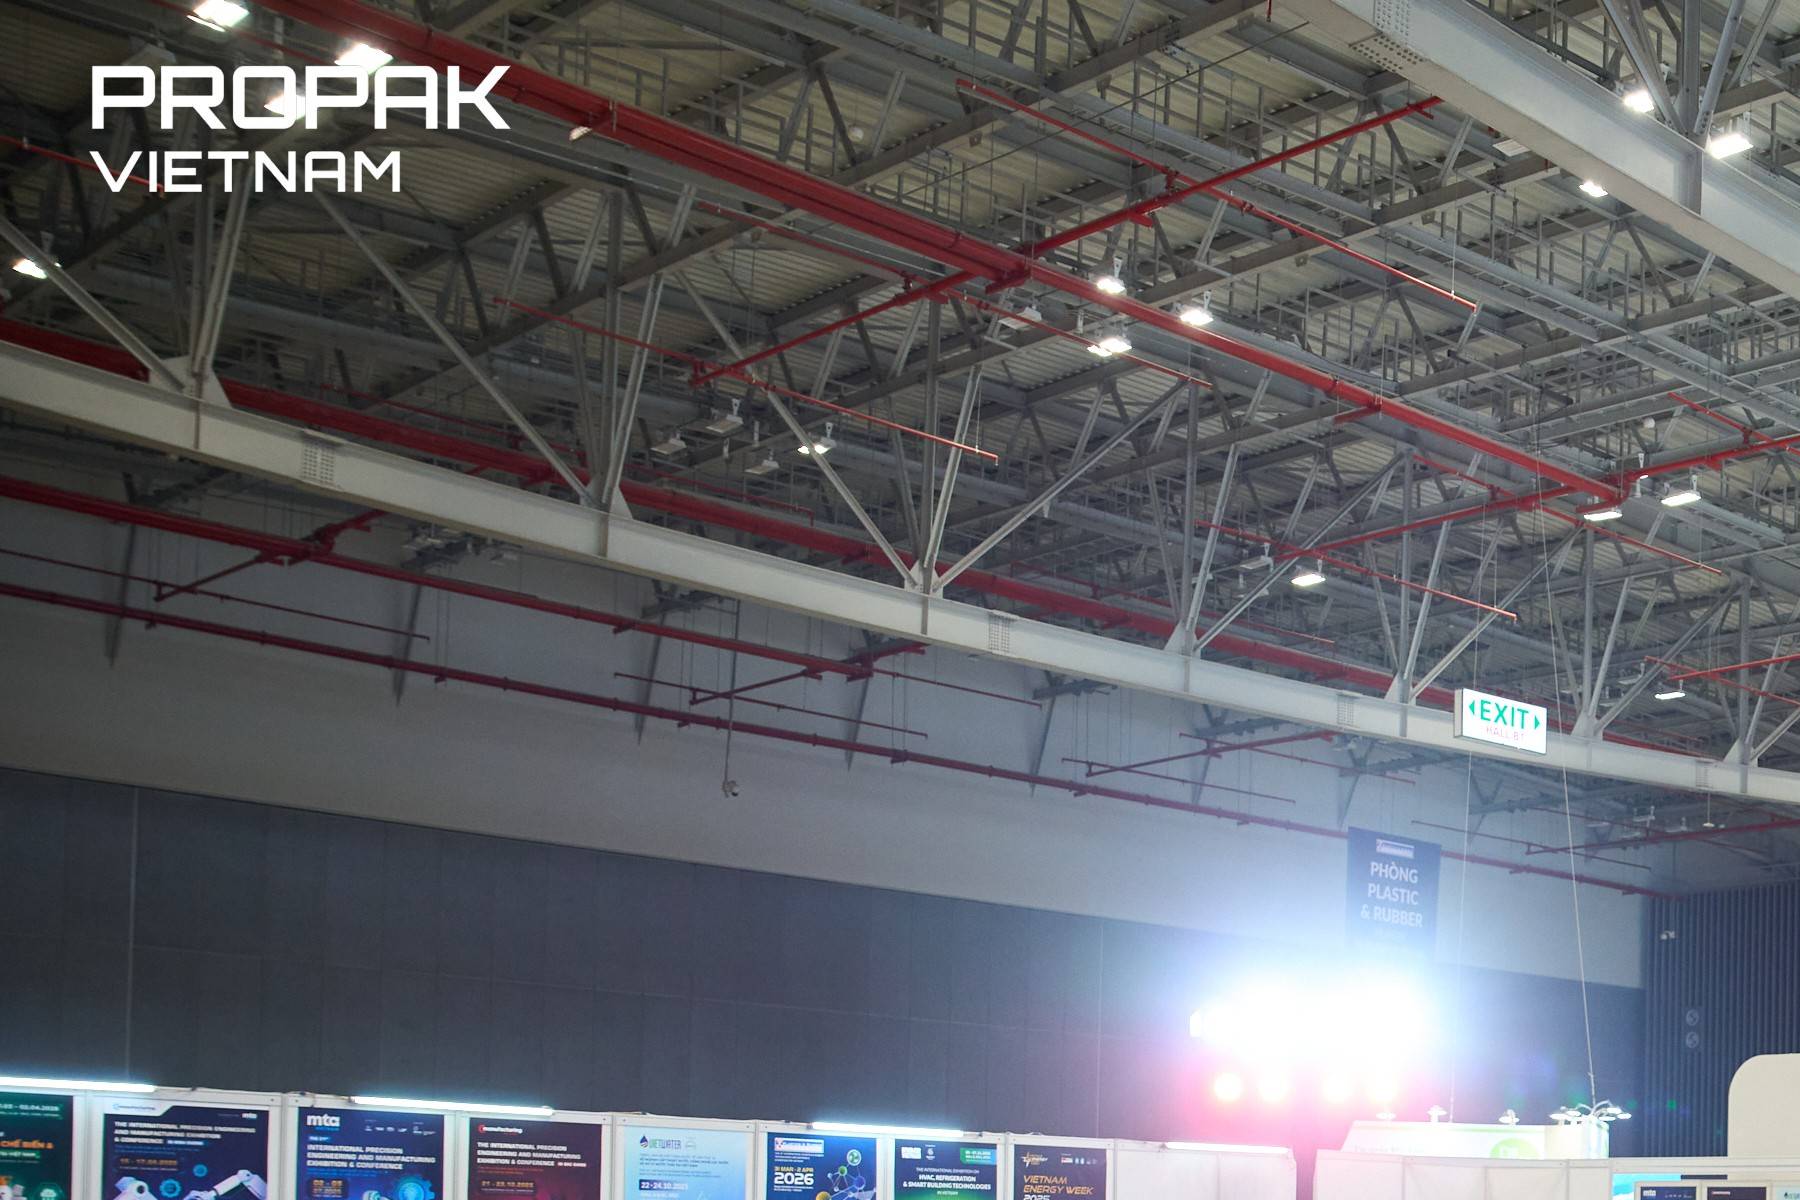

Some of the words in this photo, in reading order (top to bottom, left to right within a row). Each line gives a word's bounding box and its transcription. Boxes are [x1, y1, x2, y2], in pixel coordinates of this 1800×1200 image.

[1480, 699, 1529, 730] EXIT
[1370, 861, 1419, 884] PHÒNG
[1367, 882, 1419, 905] PLASTIC
[1360, 903, 1371, 920] &
[1373, 905, 1423, 928] RUBBER
[306, 1113, 340, 1127] mta
[307, 1144, 364, 1153] INTERNATIONAL
[365, 1146, 403, 1154] PRECISION
[490, 1142, 536, 1150] INTERNATIONAL
[307, 1152, 357, 1160] ENGINEERING
[358, 1153, 374, 1161] AND
[375, 1154, 436, 1163] MANUFACTURING
[477, 1149, 518, 1157] ENGINEERING
[532, 1152, 581, 1160] MANUFACTURING
[307, 1160, 347, 1168] EXHIBITION
[356, 1161, 403, 1170] CONFERENCE
[477, 1157, 510, 1165] EXHIBITION
[516, 1159, 555, 1167] CONFERENCE
[773, 1171, 815, 1186] 2026
[936, 1174, 976, 1182] REFRIGERATION
[1023, 1174, 1068, 1185] VIETNAM
[1023, 1184, 1065, 1195] ENERGY
[1065, 1186, 1095, 1196] WEEK
